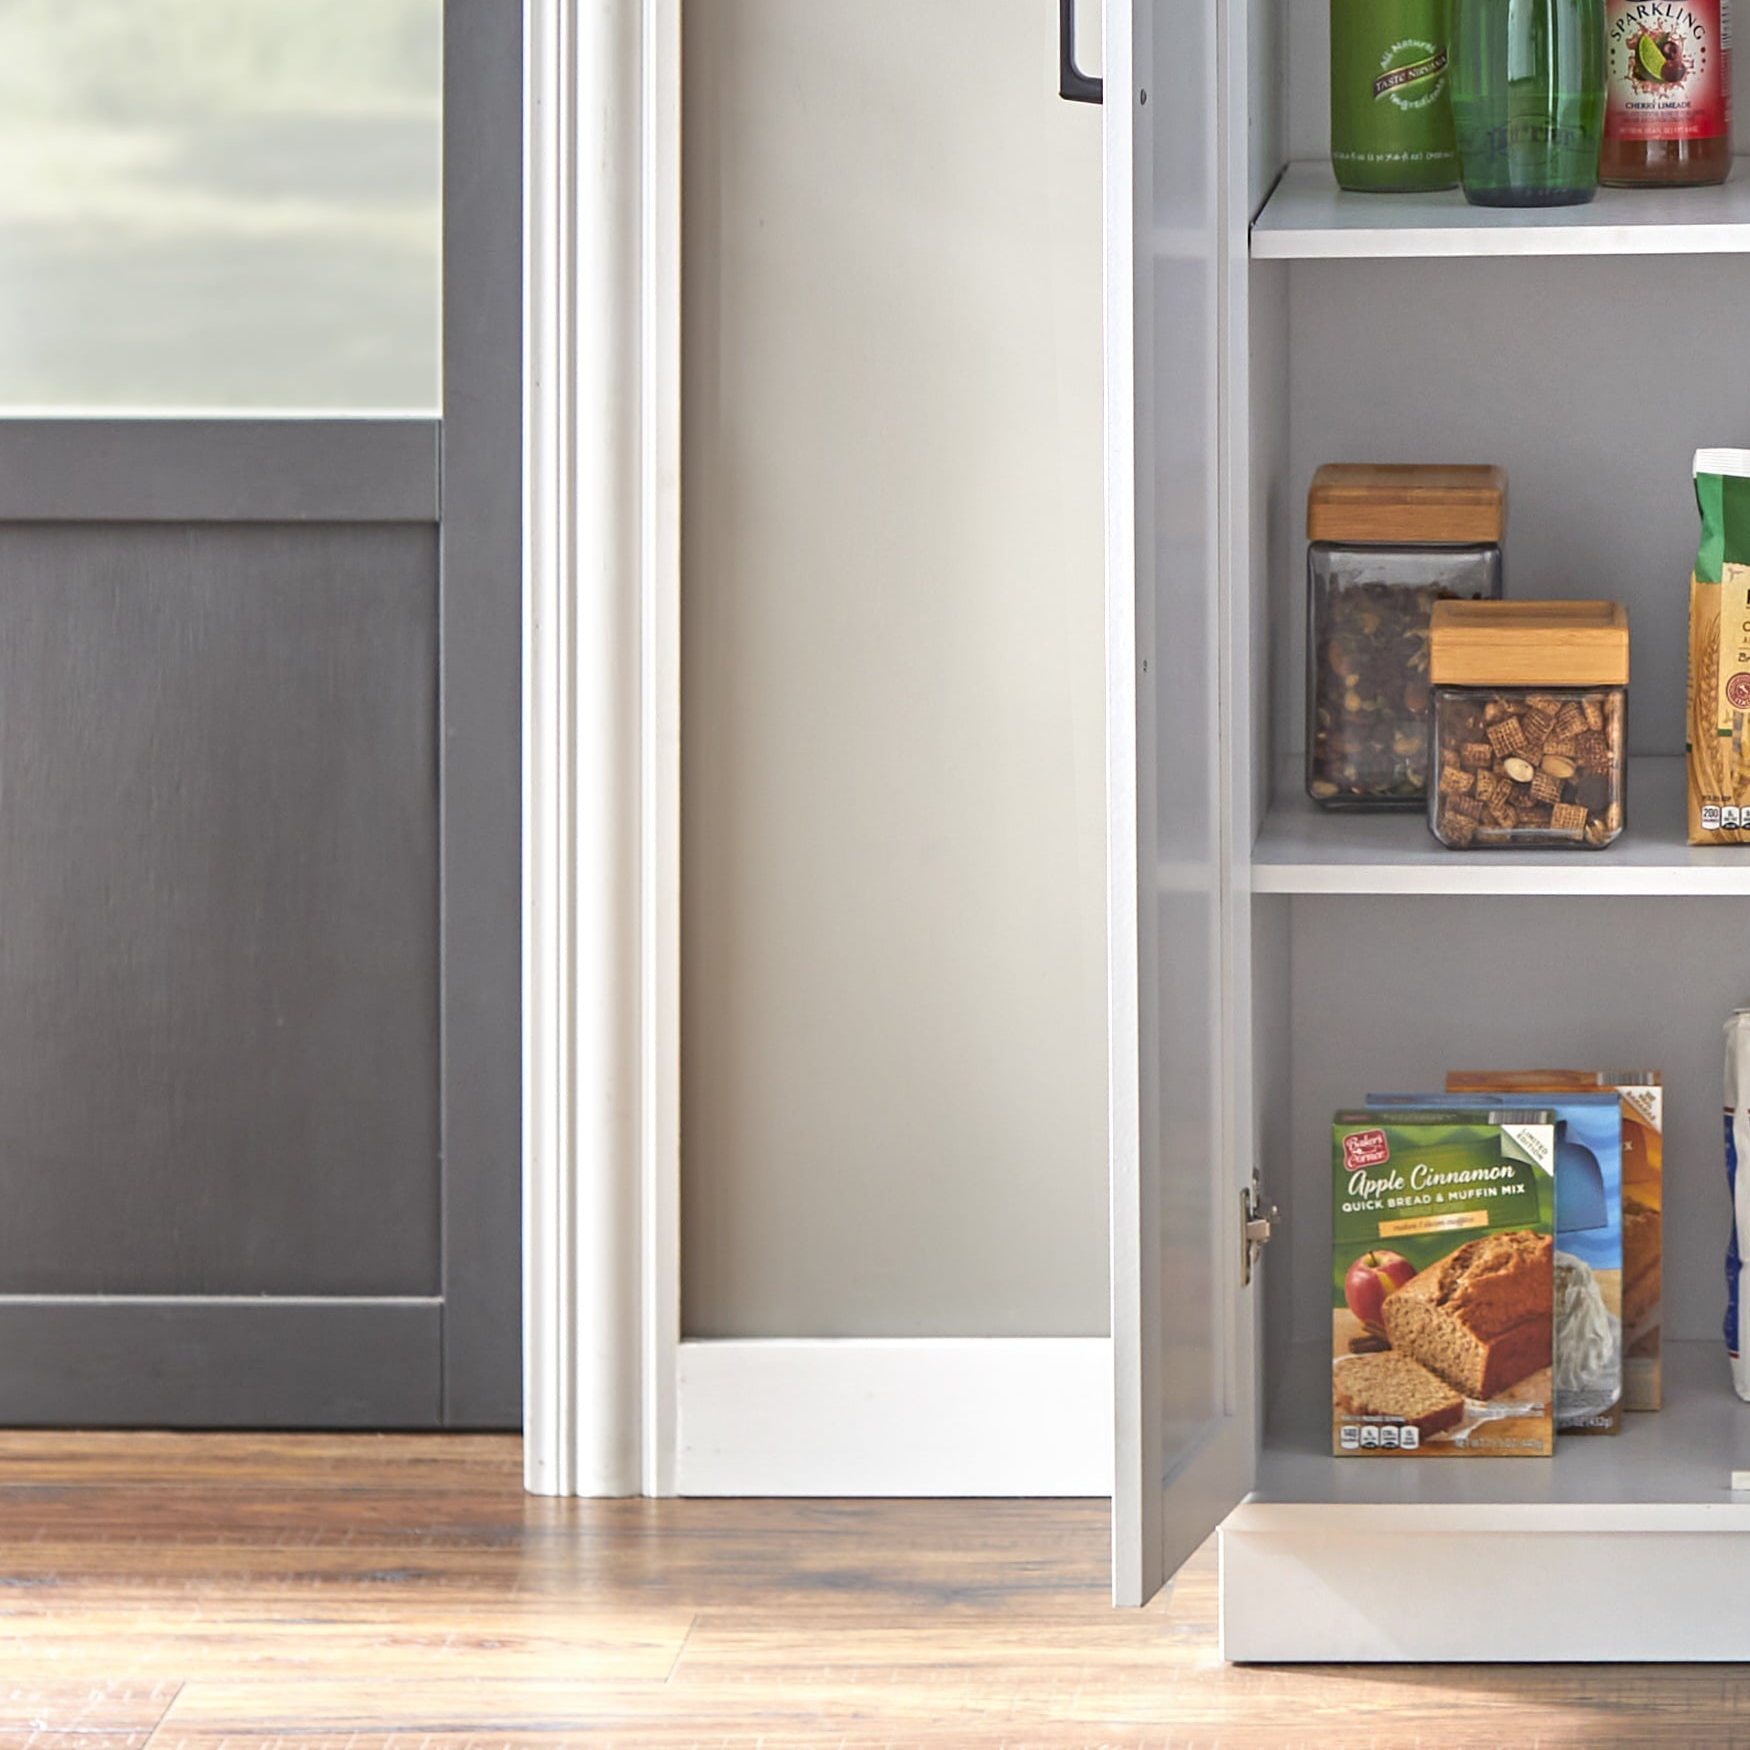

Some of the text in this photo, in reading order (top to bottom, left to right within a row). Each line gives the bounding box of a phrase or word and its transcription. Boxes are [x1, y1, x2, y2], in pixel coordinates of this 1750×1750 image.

[1611, 1, 1706, 43] SPARKLING
[1375, 70, 1408, 92] TASTE
[1657, 101, 1692, 110] LIMEADE
[1346, 1133, 1384, 1149] Baker's
[1516, 1134, 1545, 1161] EDITION
[1522, 1128, 1549, 1156] LIMITED
[1348, 1163, 1516, 1199] Apple Cinnamon
[1342, 1183, 1526, 1212] QUICK BREAD & MUFFIN MIX
